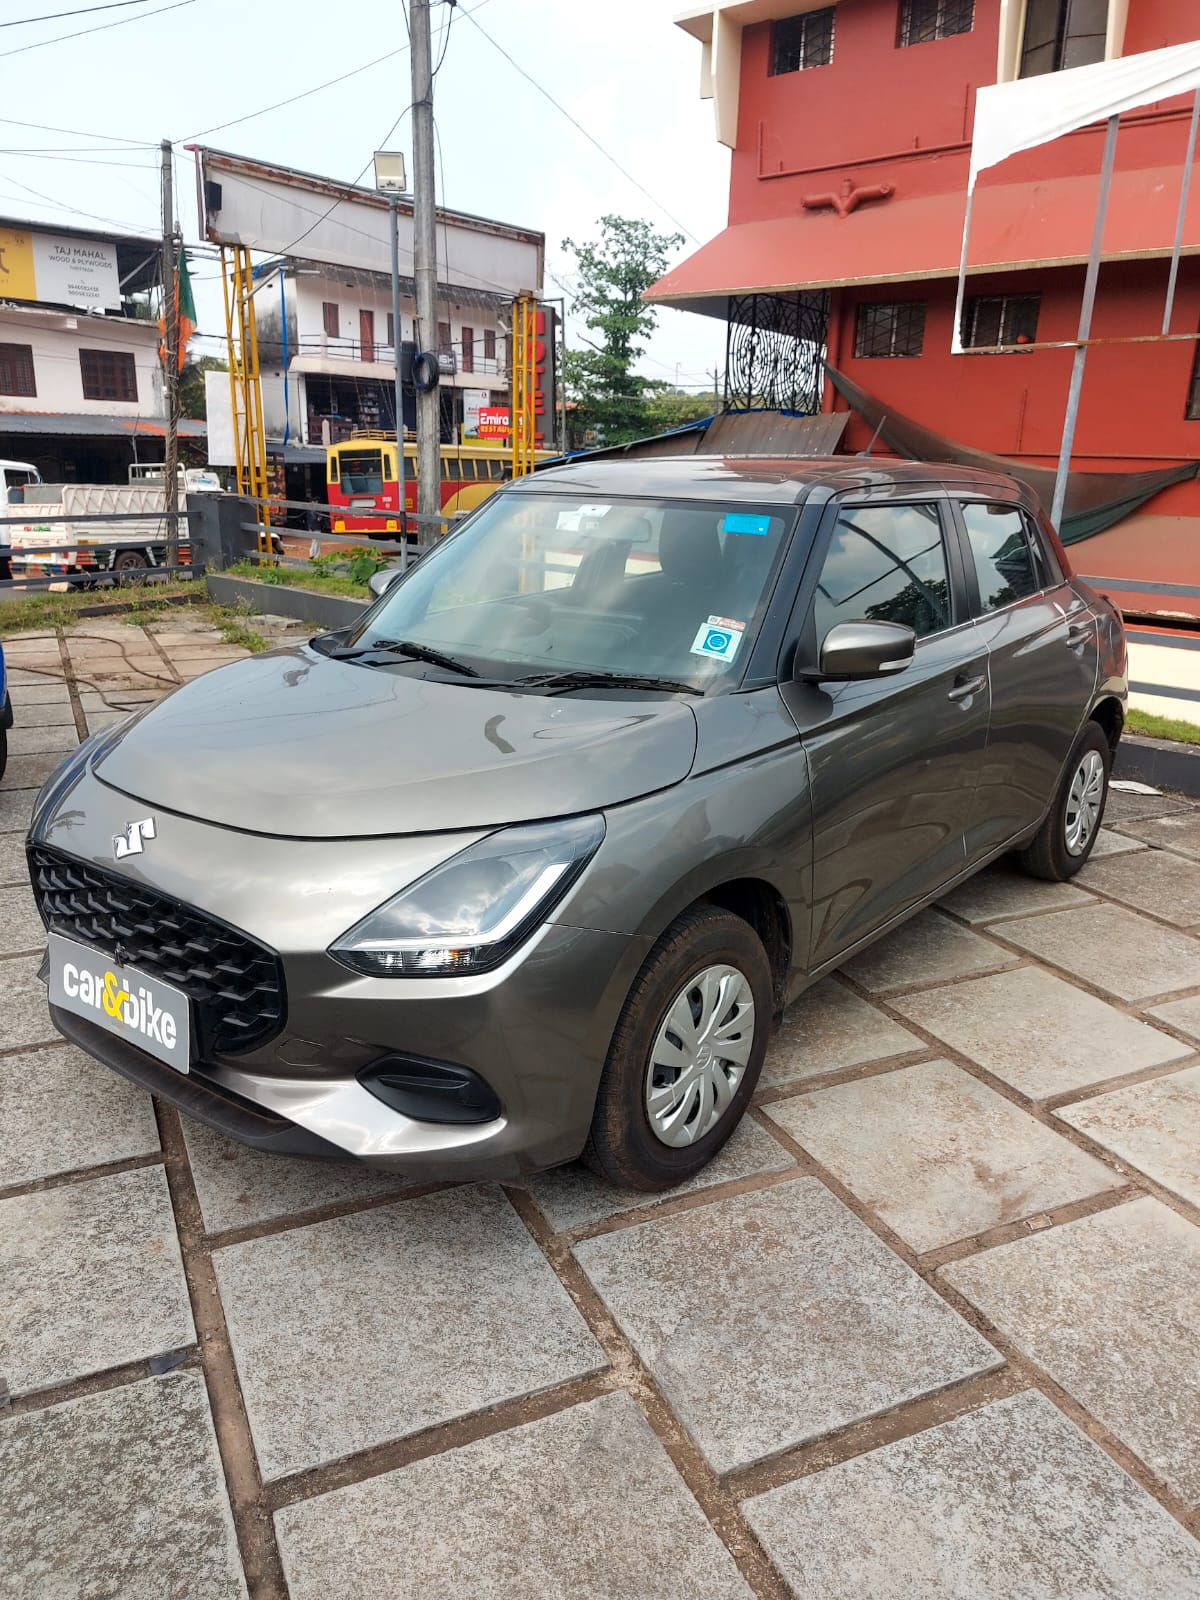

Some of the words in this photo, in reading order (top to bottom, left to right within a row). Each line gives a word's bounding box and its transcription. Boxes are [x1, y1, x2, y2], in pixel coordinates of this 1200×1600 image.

[48, 255, 70, 264] WOOD
[54, 245, 71, 256] TAJ
[74, 248, 106, 260] MAHAL
[480, 412, 523, 426] Emira
[63, 962, 177, 1050] car&bike
